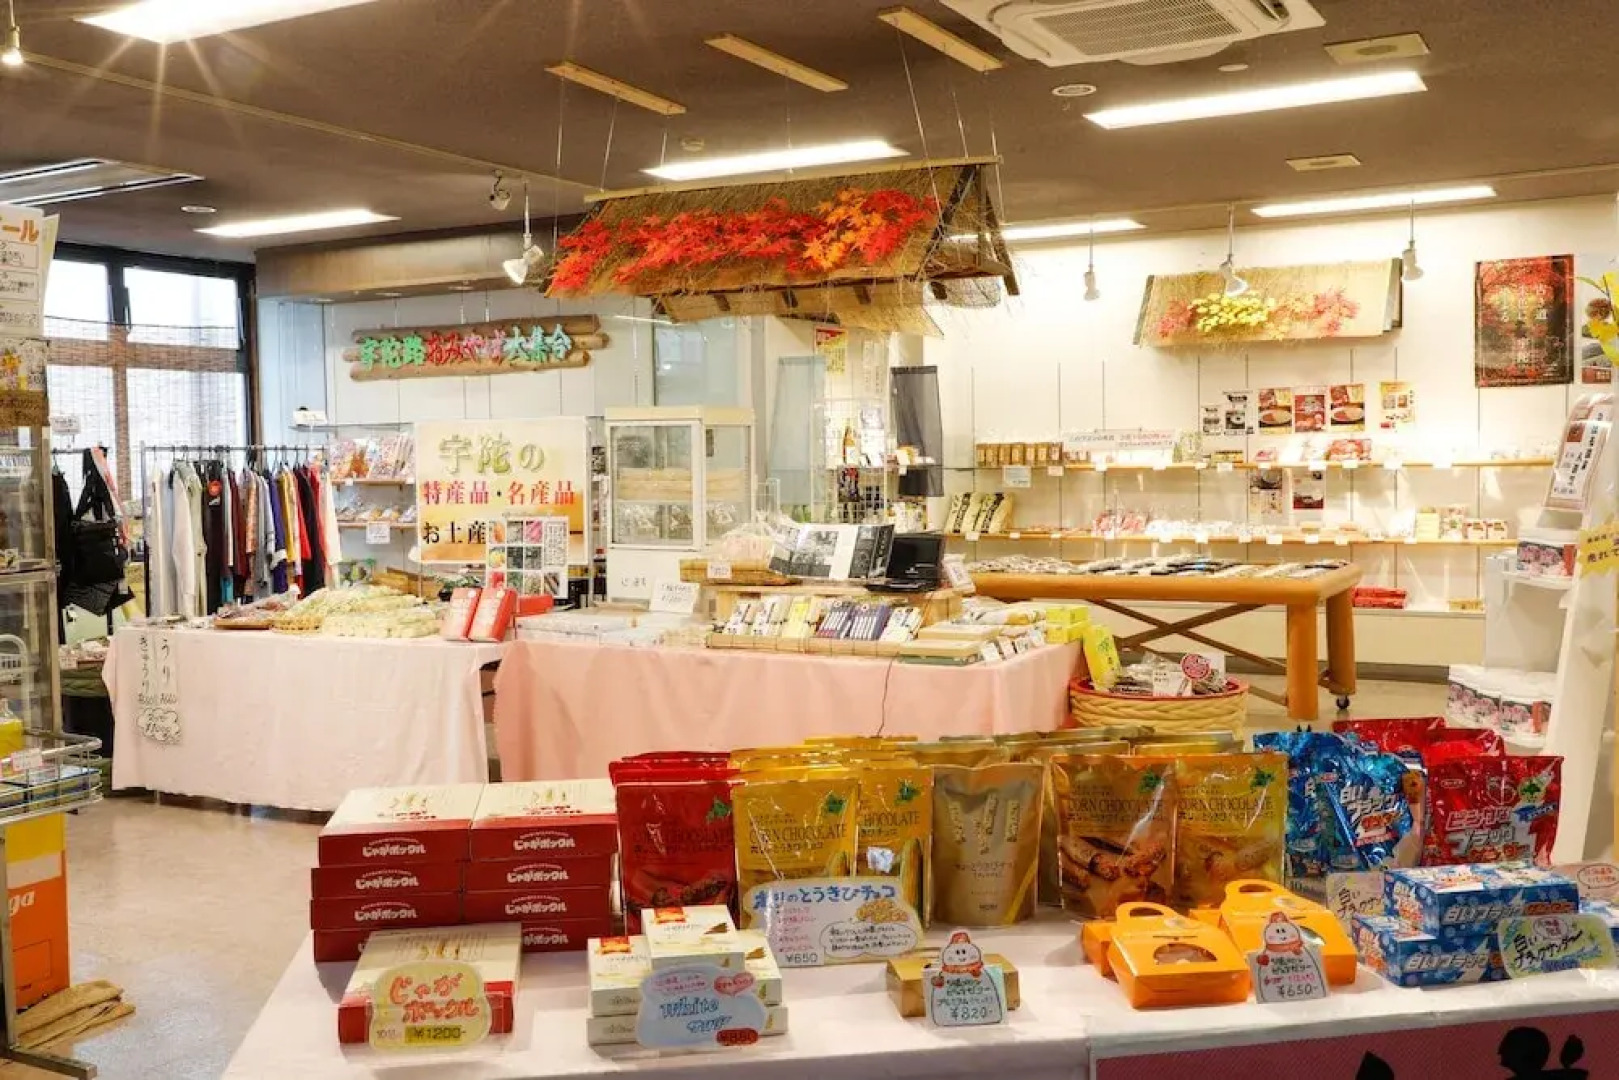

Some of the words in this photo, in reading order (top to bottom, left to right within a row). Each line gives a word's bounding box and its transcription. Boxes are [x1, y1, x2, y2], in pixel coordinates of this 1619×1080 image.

[438, 432, 545, 475] 宇陀の
[422, 480, 576, 506] 特産品・名産品
[864, 810, 921, 826] HOCOLATE
[389, 972, 464, 1006] じゃが
